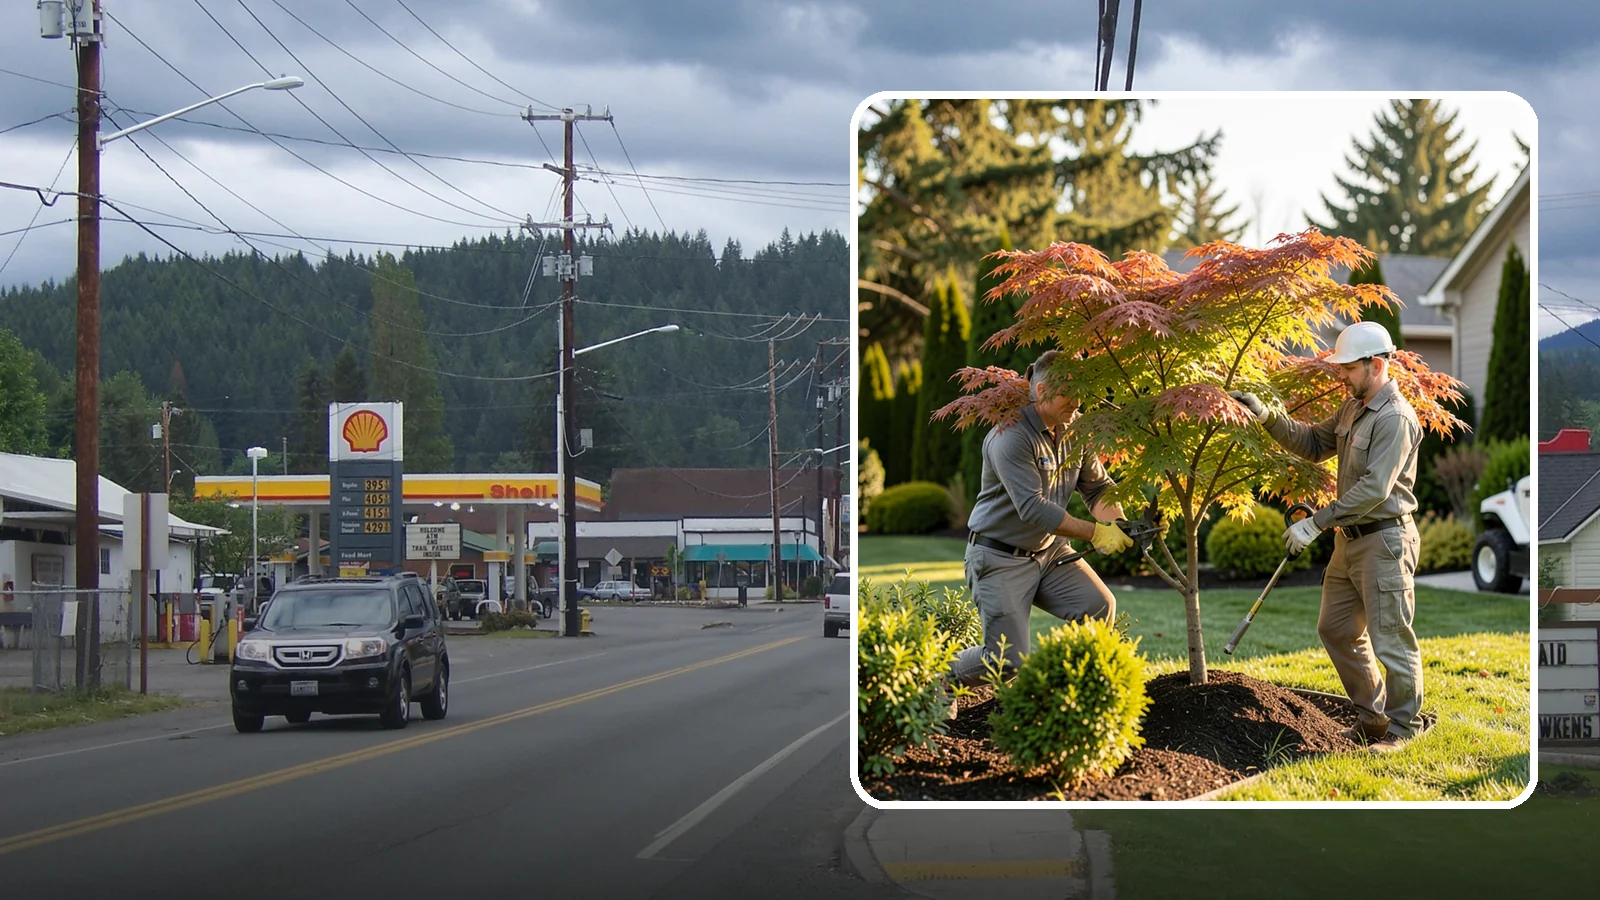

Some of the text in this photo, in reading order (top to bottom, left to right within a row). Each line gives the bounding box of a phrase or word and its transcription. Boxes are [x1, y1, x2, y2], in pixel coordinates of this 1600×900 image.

[365, 480, 384, 490] 395
[490, 484, 547, 499] Shell
[365, 494, 384, 504] 405
[365, 508, 384, 518] 415
[365, 522, 384, 532] 429
